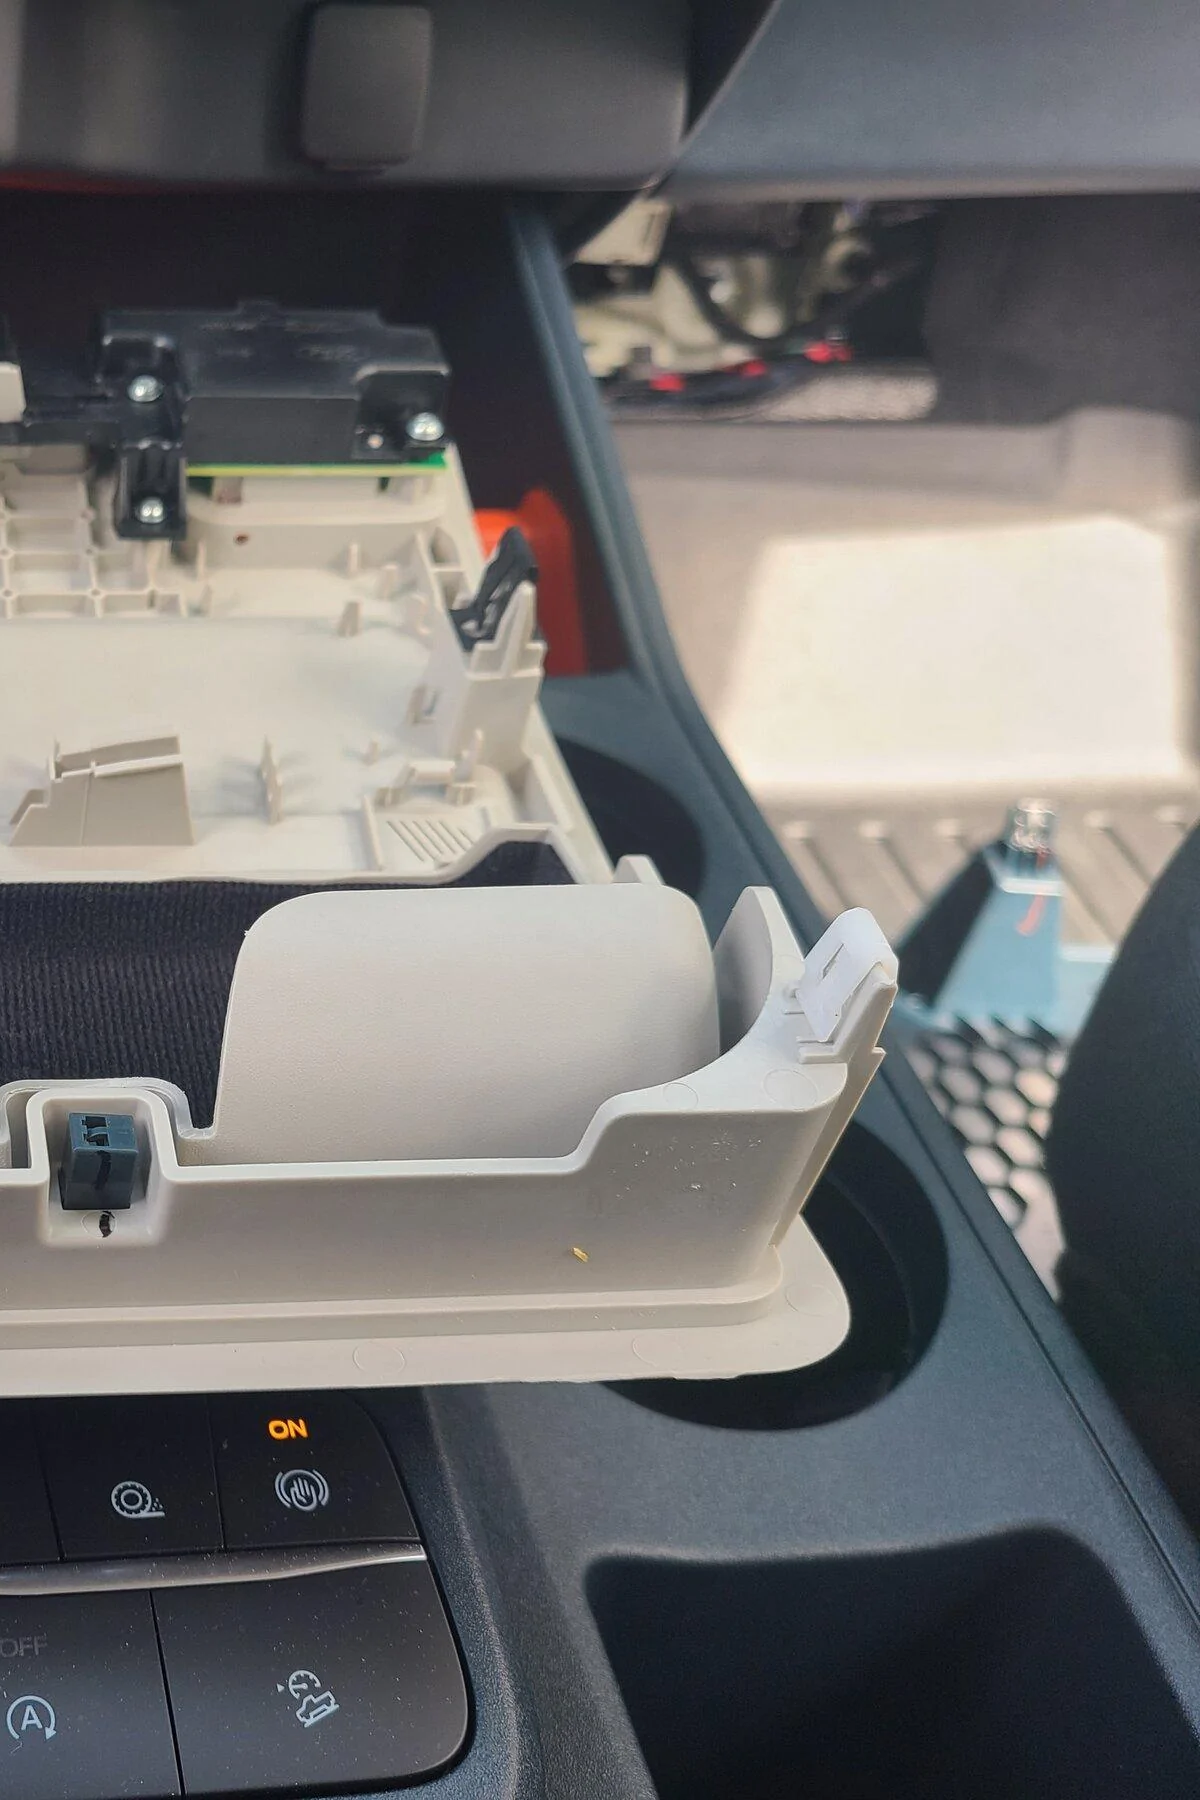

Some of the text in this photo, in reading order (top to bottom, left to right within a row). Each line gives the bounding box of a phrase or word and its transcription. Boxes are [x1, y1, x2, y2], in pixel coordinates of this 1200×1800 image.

[268, 1419, 308, 1440] ON
[0, 1636, 48, 1658] OFF
[21, 1705, 43, 1731] A
